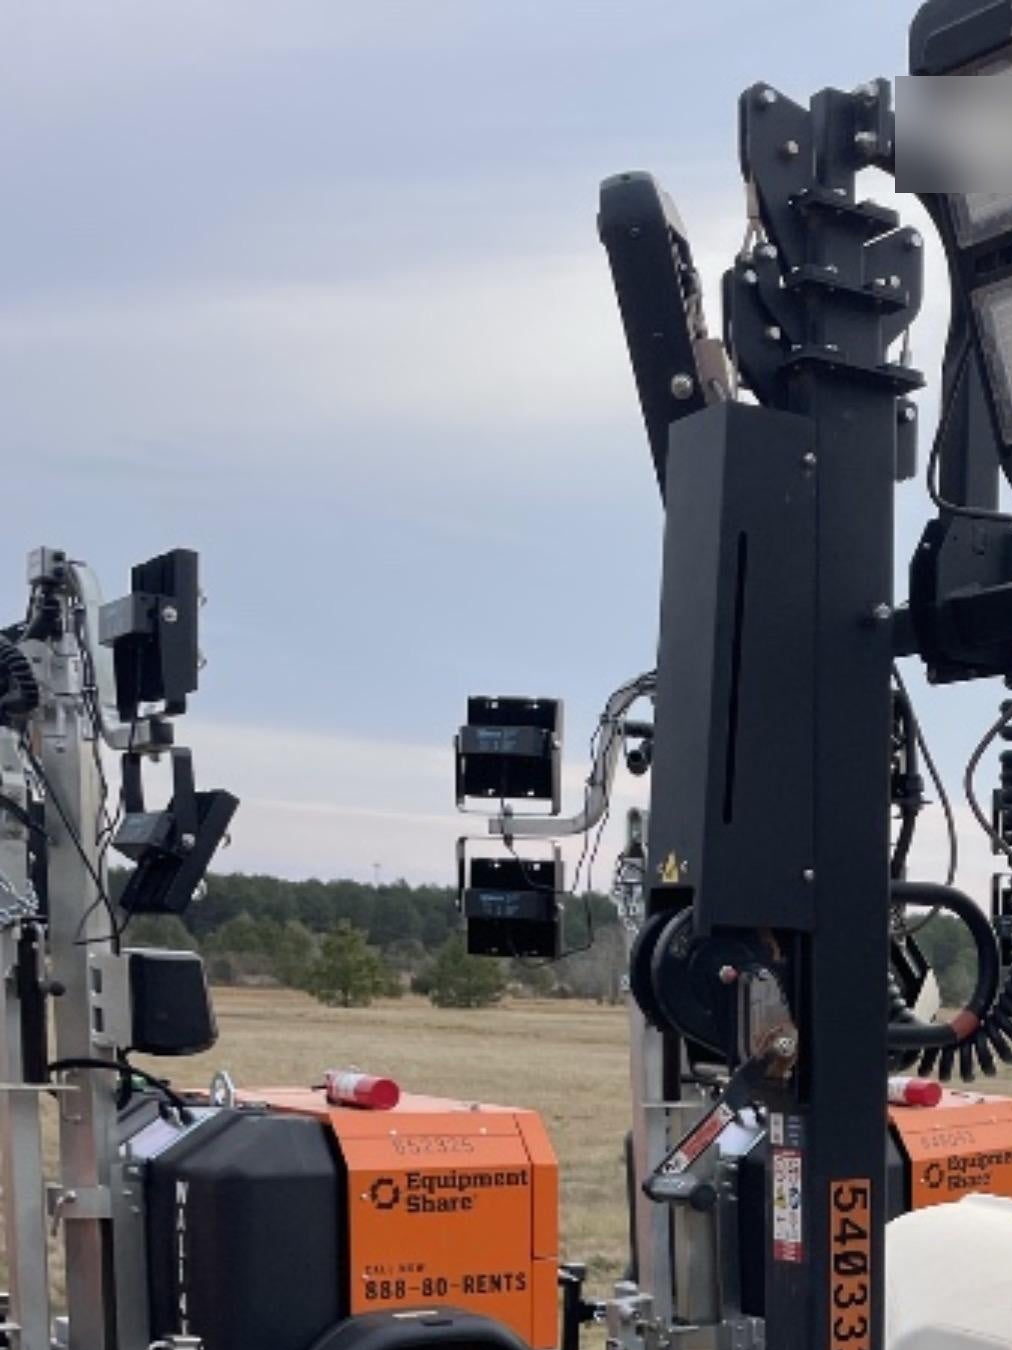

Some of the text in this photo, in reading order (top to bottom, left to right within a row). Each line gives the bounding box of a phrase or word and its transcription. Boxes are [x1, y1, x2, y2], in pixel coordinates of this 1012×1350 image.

[405, 1170, 529, 1194] Equipment
[406, 1195, 474, 1213] Share
[364, 1272, 527, 1300] 888-80-RENTS
